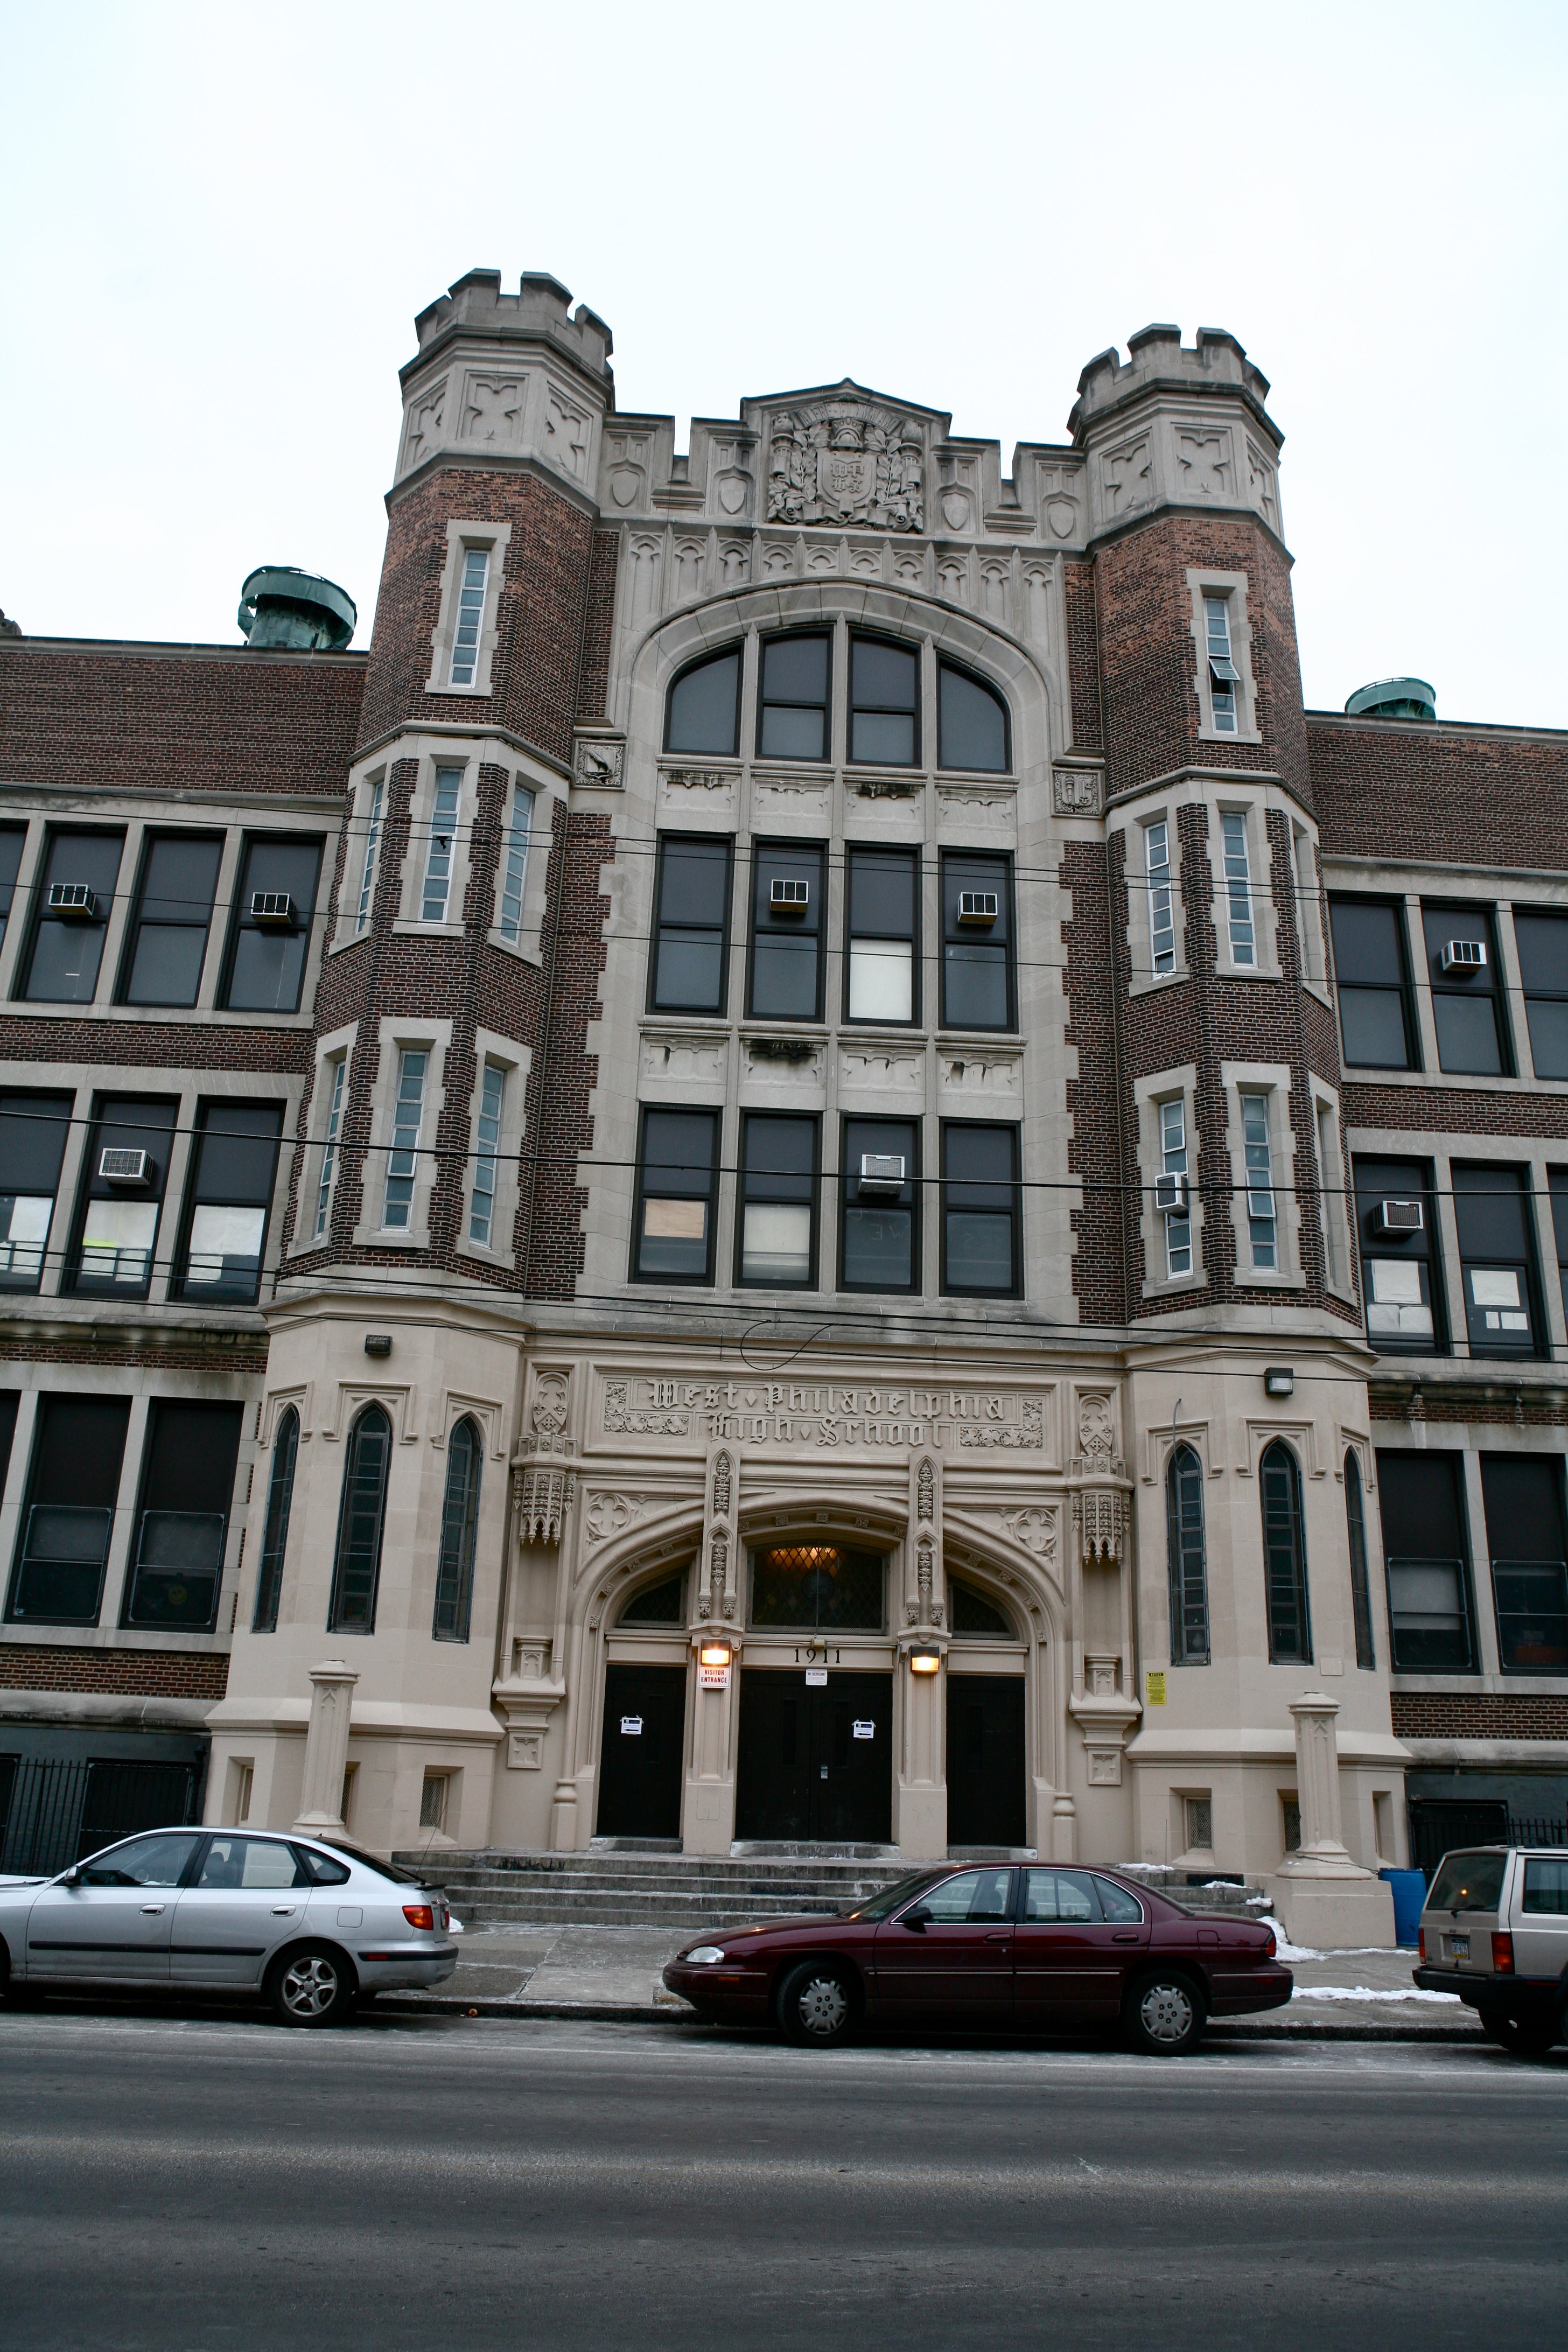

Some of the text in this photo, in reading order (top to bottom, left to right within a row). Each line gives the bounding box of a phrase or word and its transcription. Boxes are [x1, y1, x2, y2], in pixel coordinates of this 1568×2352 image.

[646, 1379, 1004, 1420] West Philadelphia
[708, 1412, 942, 1447] High School
[795, 1648, 841, 1663] 1911
